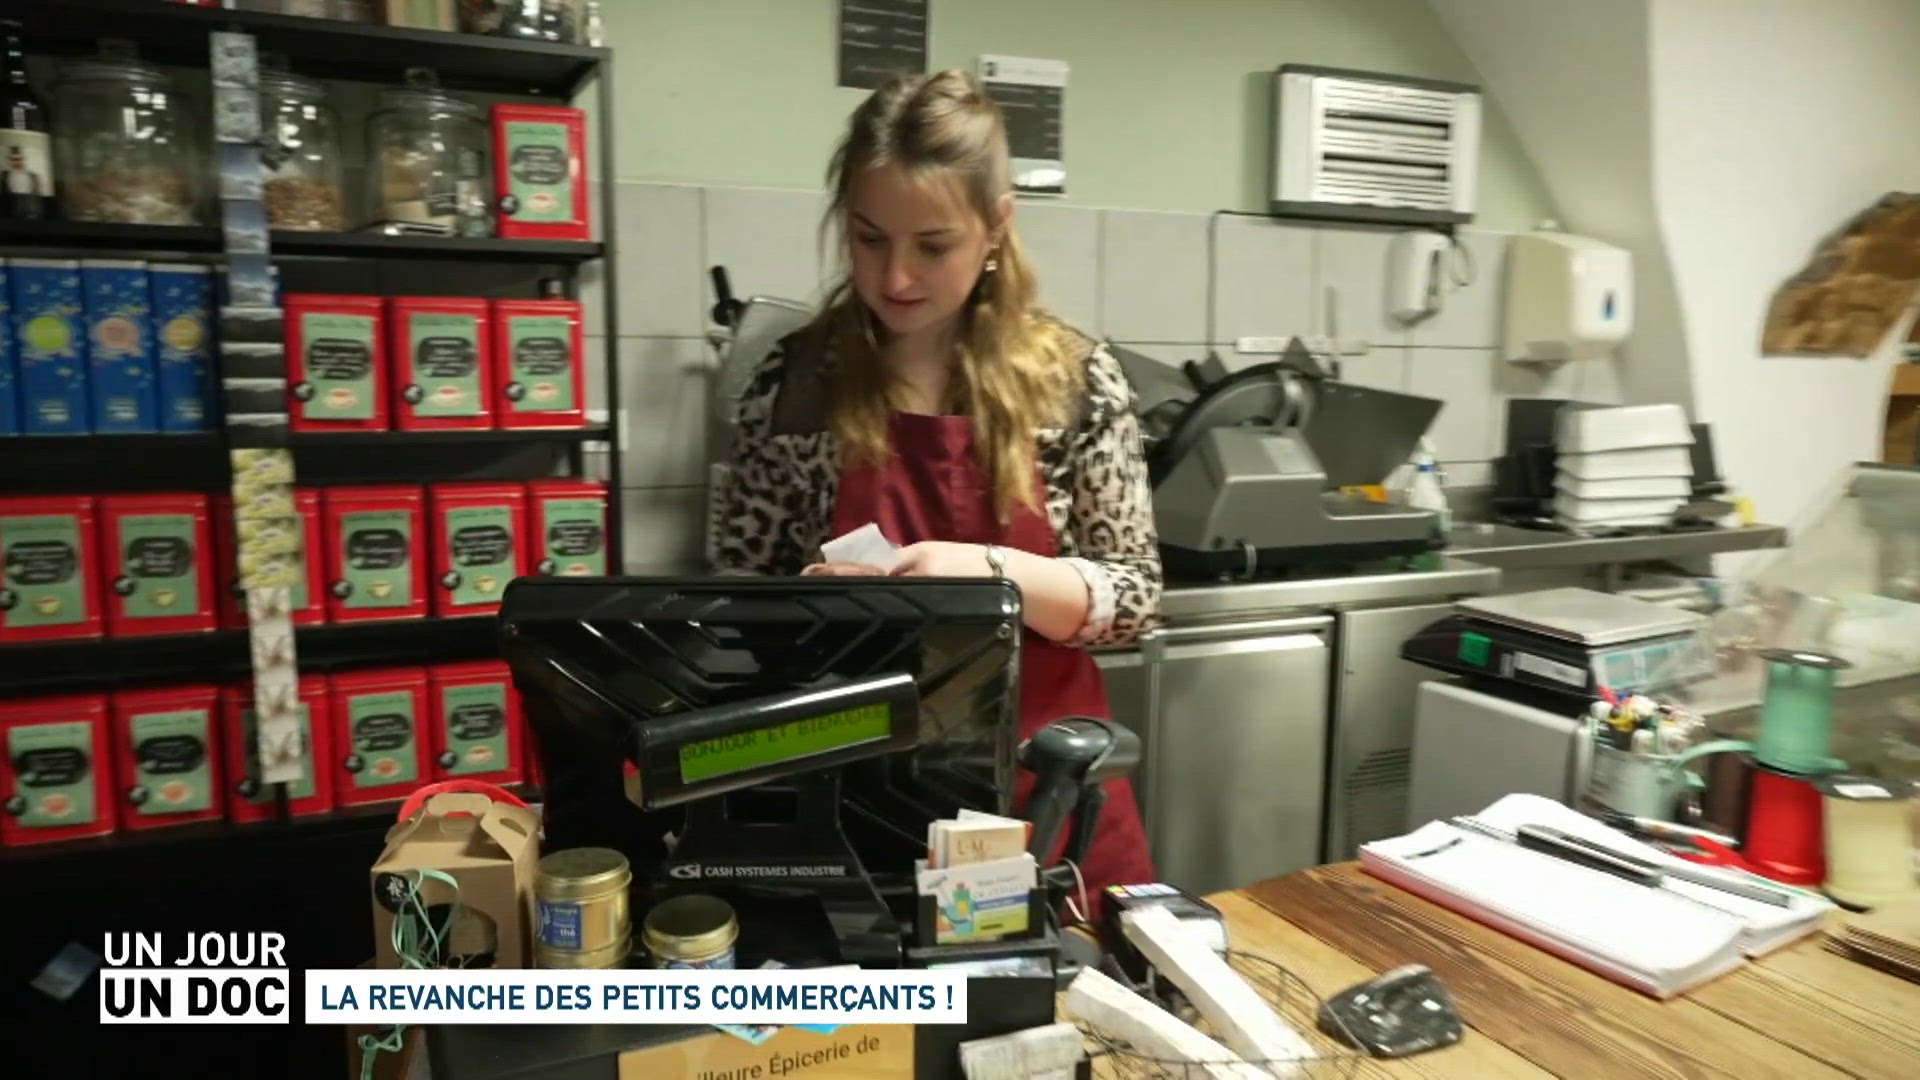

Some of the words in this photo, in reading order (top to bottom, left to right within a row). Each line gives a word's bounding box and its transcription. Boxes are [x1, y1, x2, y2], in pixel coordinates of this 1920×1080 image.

[681, 731, 757, 761] BONJOUR
[767, 726, 788, 743] ET
[704, 865, 734, 877] CASH
[735, 865, 788, 877] SYSTEMES
[790, 864, 846, 877] INDUSTRIE
[769, 1041, 851, 1077] Épicerie
[855, 1034, 881, 1054] de
